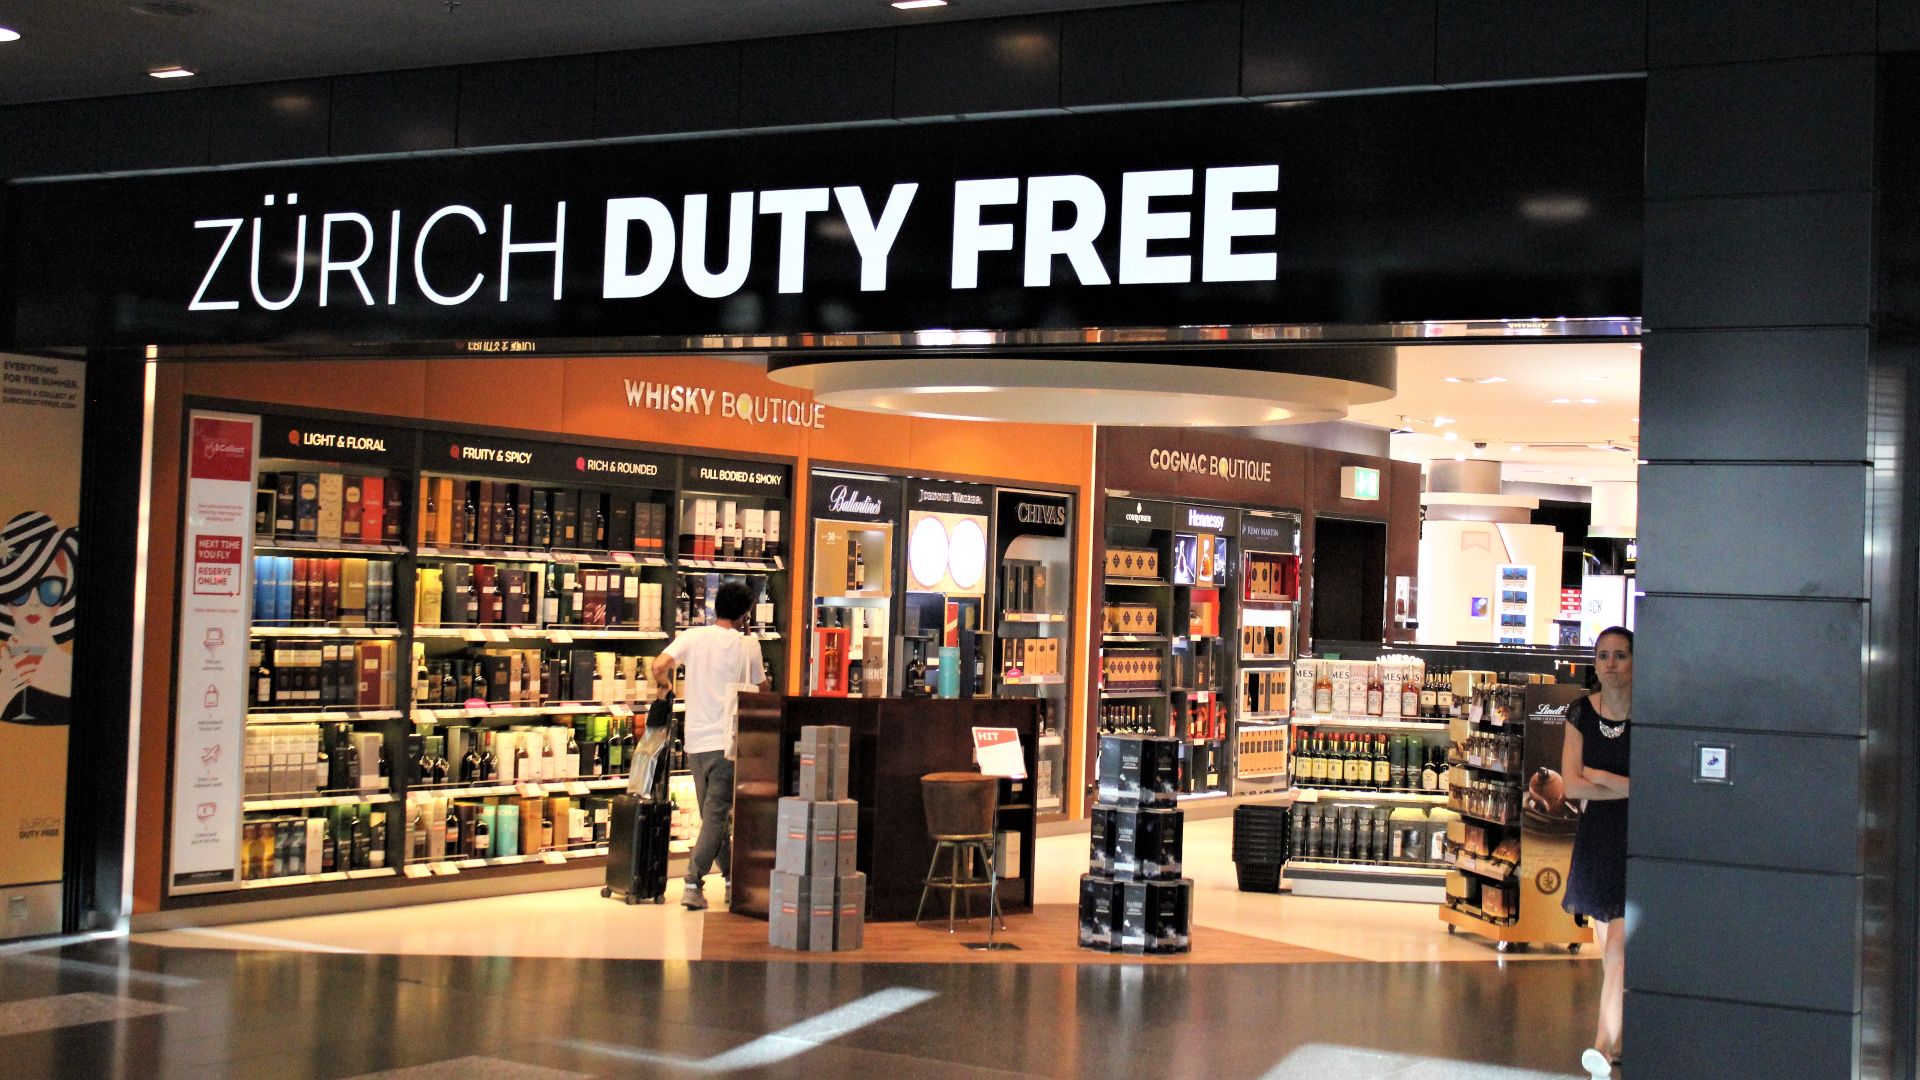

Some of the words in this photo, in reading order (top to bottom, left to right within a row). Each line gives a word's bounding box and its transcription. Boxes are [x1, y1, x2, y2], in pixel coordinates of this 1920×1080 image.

[188, 192, 566, 311] ZÜRICH
[602, 182, 919, 299] DUTY
[951, 164, 1280, 290] FREE
[4, 361, 58, 374] EVERYTHING
[4, 373, 21, 382] FOR
[624, 379, 715, 415] WHISKY
[721, 391, 825, 429] BOUTIQUE
[303, 432, 336, 447] LIGHT
[337, 436, 345, 448] &
[347, 437, 387, 452] FLORAL
[462, 447, 496, 461] FRUITY
[497, 450, 504, 462] &
[505, 451, 533, 464] SPICY
[587, 459, 608, 471] RICH
[609, 462, 617, 472] &
[618, 462, 658, 476] ROUNDED
[1150, 448, 1207, 475] COGNAC
[1209, 456, 1272, 482] BOUTIQUE
[700, 467, 718, 479] FULL
[719, 469, 748, 482] BODIED
[748, 472, 755, 483] &
[755, 473, 782, 486] SMOKY
[829, 484, 882, 515] Ballantine's
[1017, 502, 1066, 527] CHIVAS
[1188, 509, 1226, 532] Hennessy
[199, 539, 219, 549] NEXT
[221, 540, 241, 550] TIME
[198, 550, 216, 559] YOU
[216, 551, 231, 560] FLY
[198, 567, 232, 576] RESERVE
[977, 732, 999, 741] HIT
